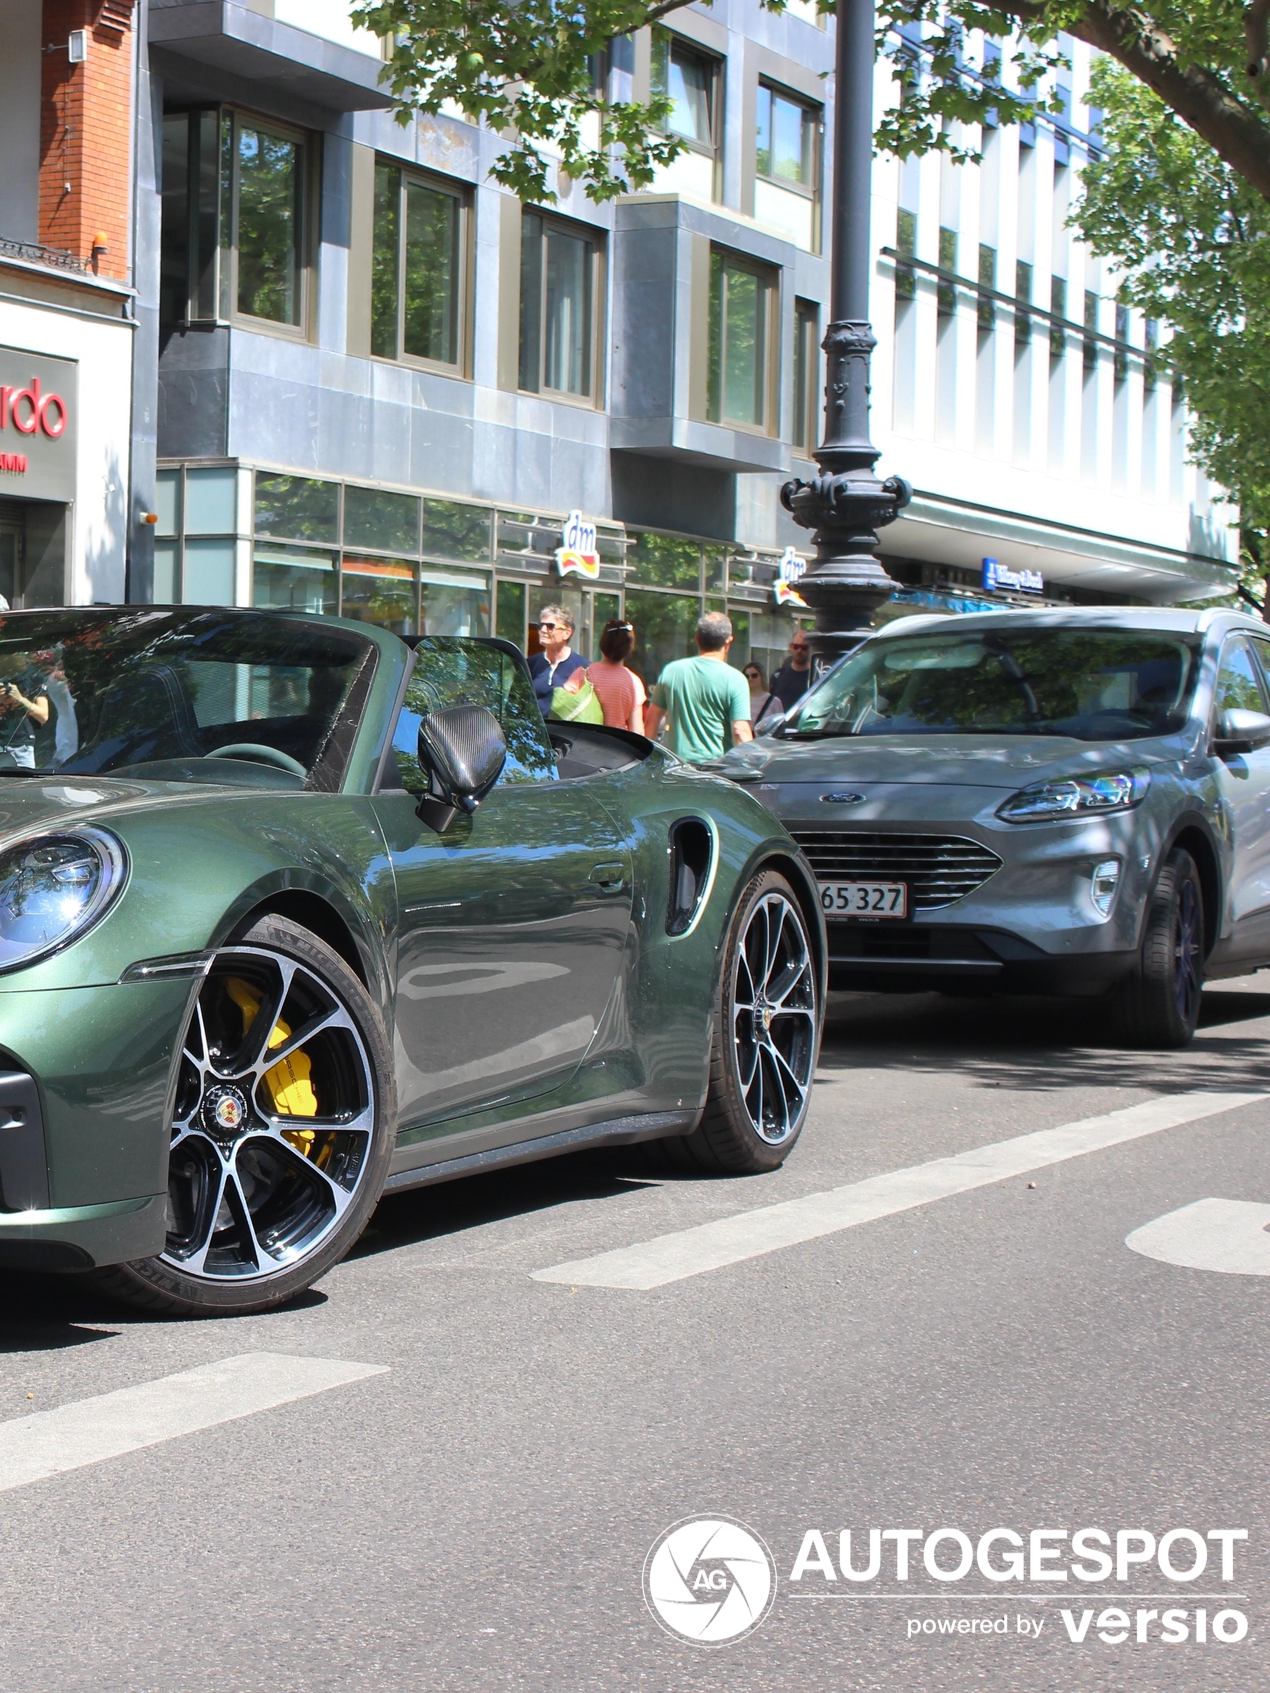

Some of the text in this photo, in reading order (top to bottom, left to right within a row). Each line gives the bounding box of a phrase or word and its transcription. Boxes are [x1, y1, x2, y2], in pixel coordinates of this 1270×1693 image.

[569, 514, 594, 552] dm
[821, 886, 901, 911] 65 327
